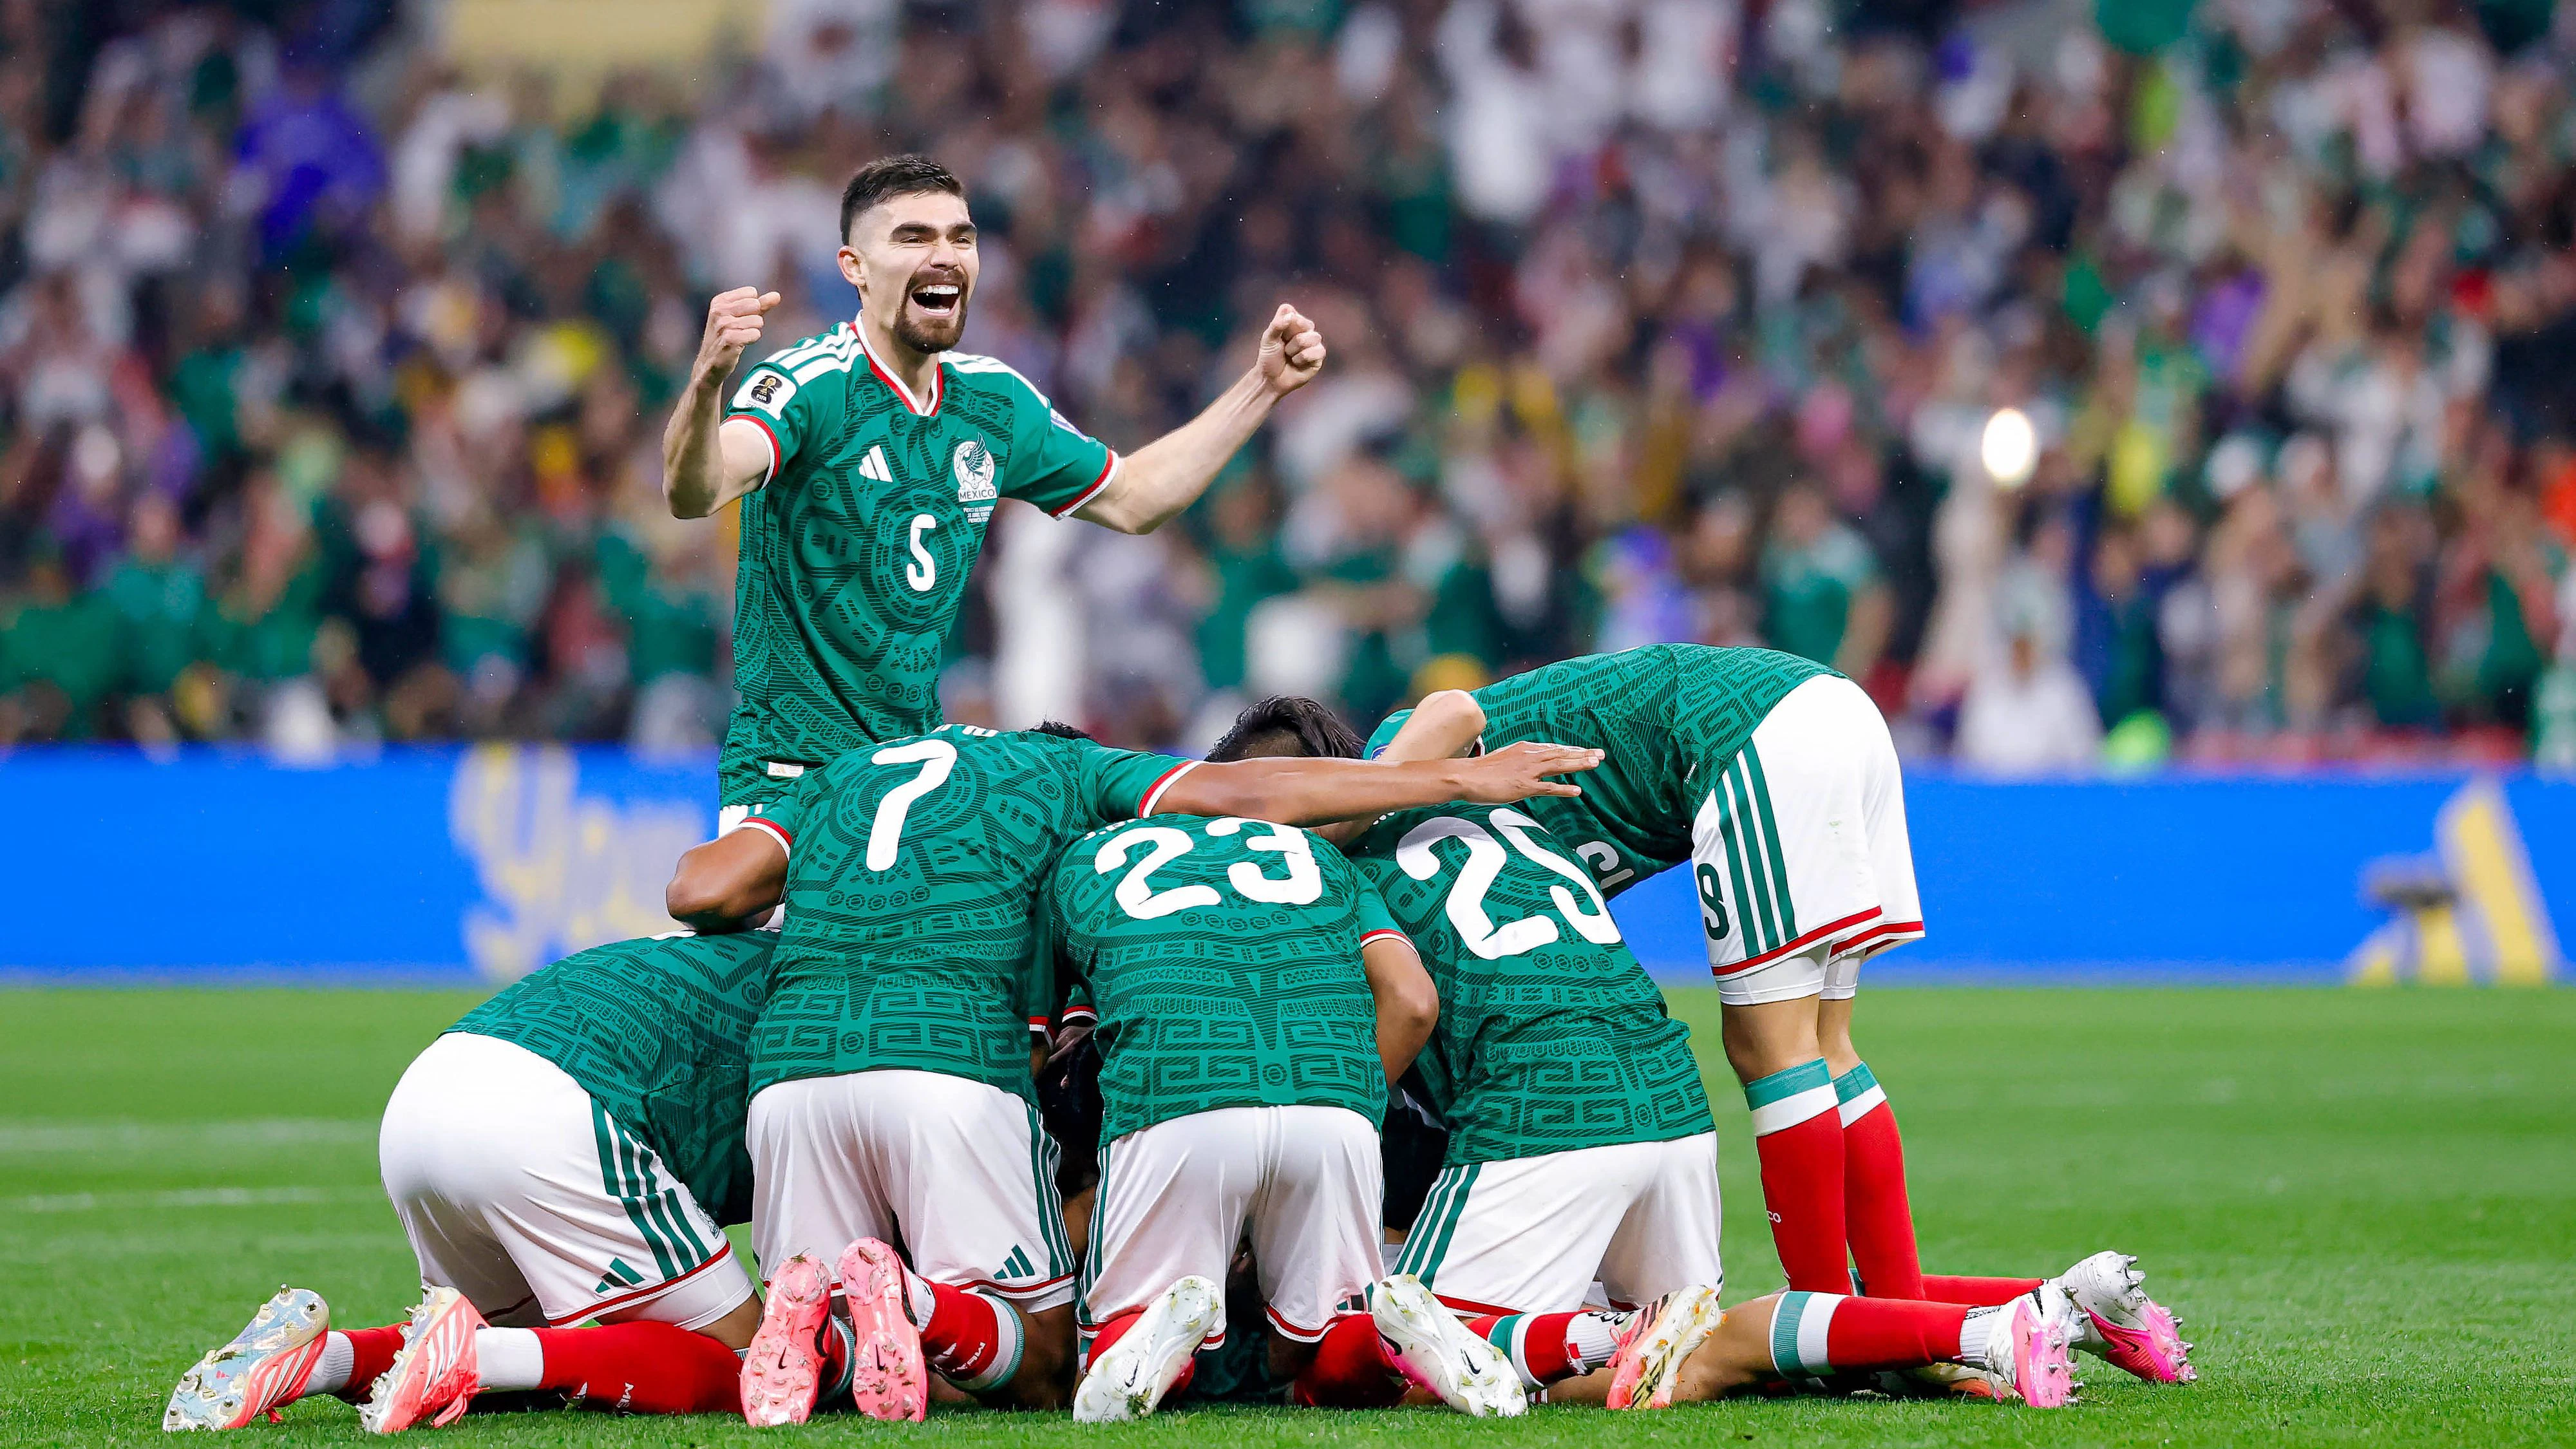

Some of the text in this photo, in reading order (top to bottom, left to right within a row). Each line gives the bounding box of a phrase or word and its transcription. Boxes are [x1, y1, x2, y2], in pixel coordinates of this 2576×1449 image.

[907, 514, 936, 592] 5
[866, 739, 958, 872] 7
[1095, 817, 1323, 920] 23
[1396, 808, 1622, 960] 25
[1697, 863, 1730, 940] 8
